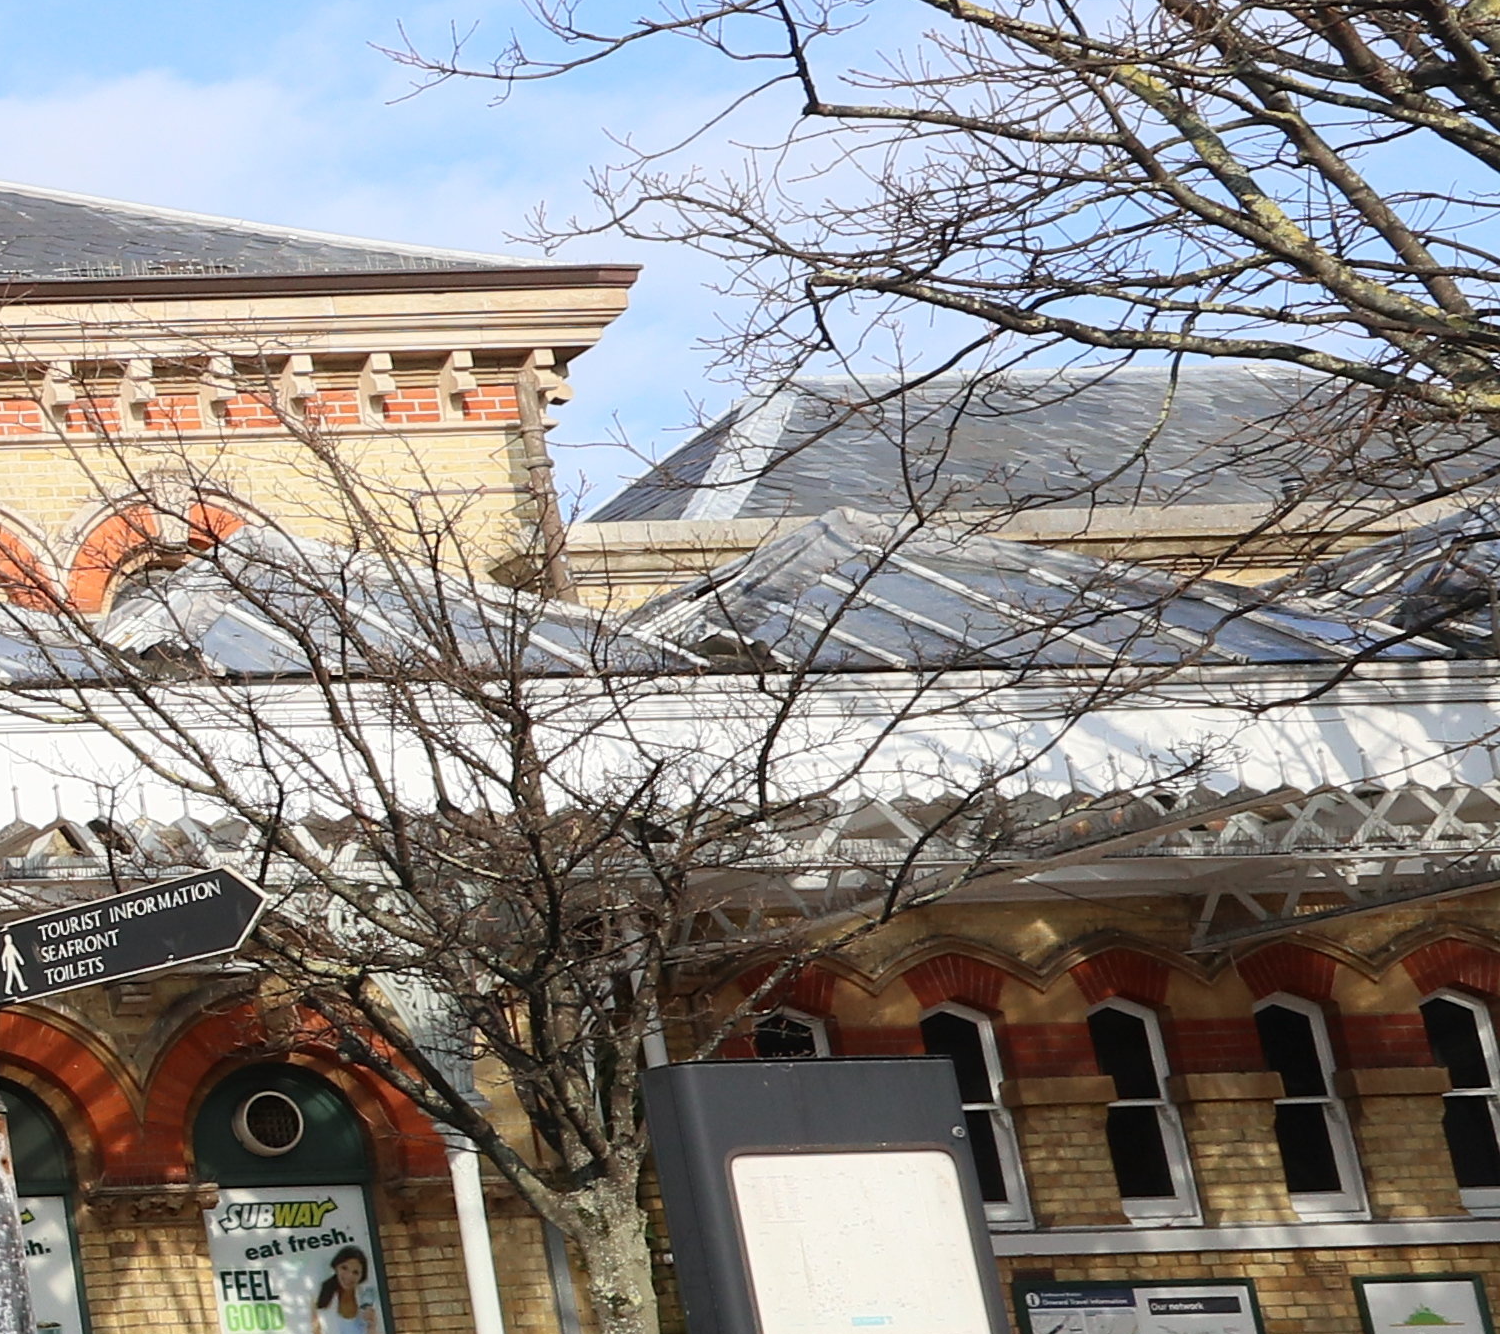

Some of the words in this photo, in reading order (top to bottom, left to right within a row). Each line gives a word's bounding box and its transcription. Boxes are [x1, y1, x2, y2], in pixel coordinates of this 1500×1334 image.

[37, 909, 103, 942] TOURIST
[108, 878, 222, 924] INFORMATION
[40, 929, 121, 964] SEAFRONT
[44, 956, 105, 986] TOILETS
[219, 1198, 338, 1234] SUBWAY
[245, 1239, 283, 1261] eat
[288, 1228, 355, 1253] fresh.
[220, 1270, 279, 1302] FEEL
[225, 1303, 286, 1332] GOOD
[1150, 1302, 1167, 1312] Our
[1168, 1302, 1204, 1311] network
